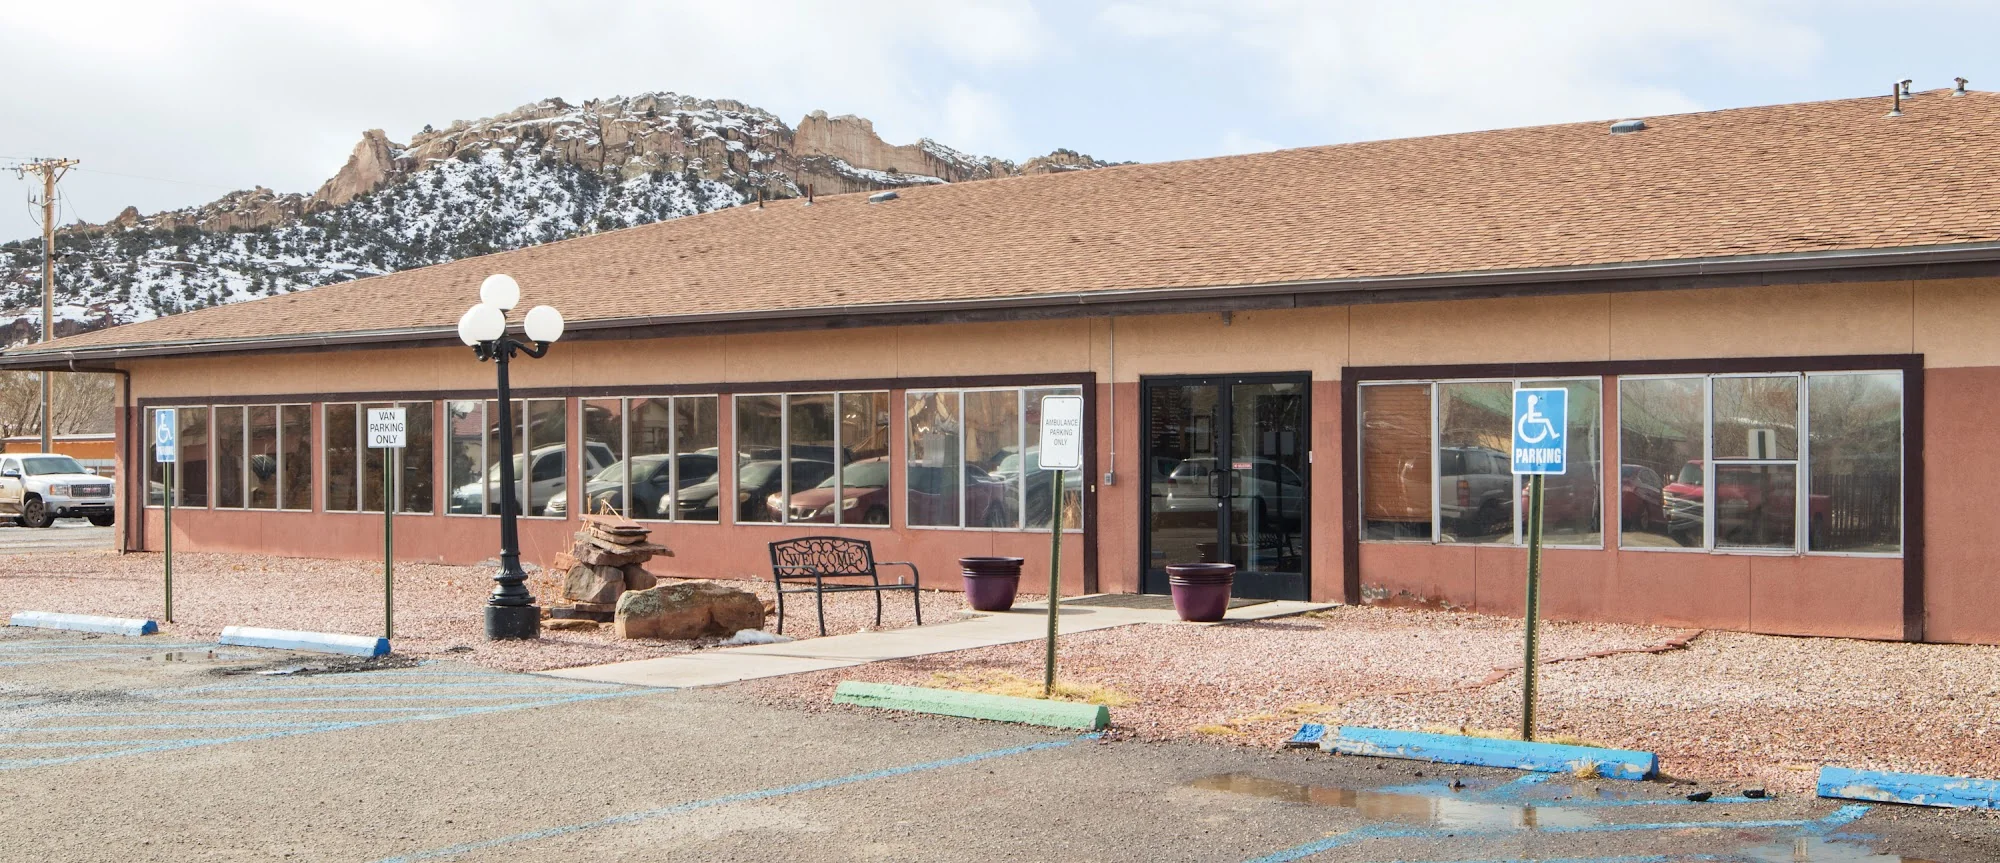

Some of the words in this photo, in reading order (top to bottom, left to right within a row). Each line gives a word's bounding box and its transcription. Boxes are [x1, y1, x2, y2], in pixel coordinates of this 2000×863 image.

[379, 411, 396, 421] VAN
[1045, 418, 1079, 427] AMBULANCE
[370, 423, 404, 432] PARKING
[1050, 428, 1073, 436] PARKING
[376, 434, 398, 444] ONLY
[1054, 438, 1068, 446] ONLY
[1515, 447, 1562, 464] PARKING
[787, 551, 857, 567] WELCOME
